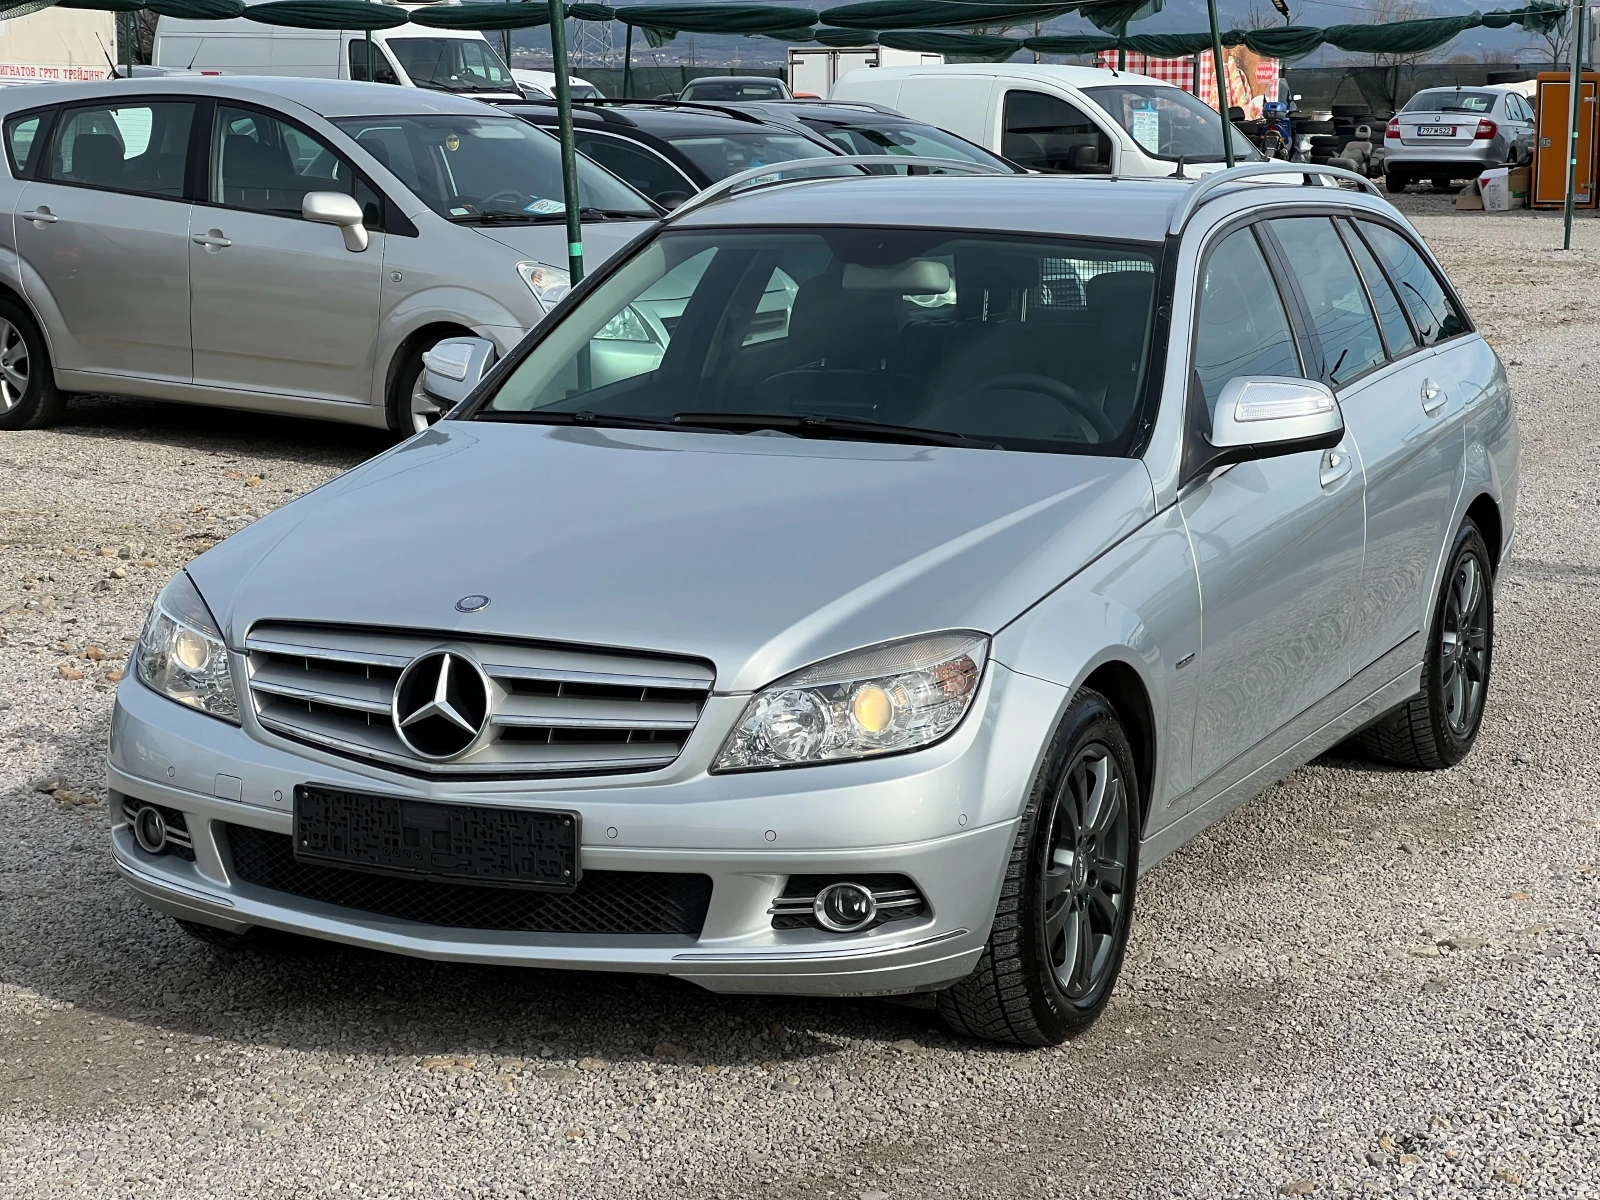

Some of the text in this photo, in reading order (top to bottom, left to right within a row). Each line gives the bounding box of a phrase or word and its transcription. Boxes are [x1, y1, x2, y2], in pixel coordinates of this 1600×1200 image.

[0, 66, 105, 80] ИГНАТОВ ГРУП ТРЕЙДИНГ
